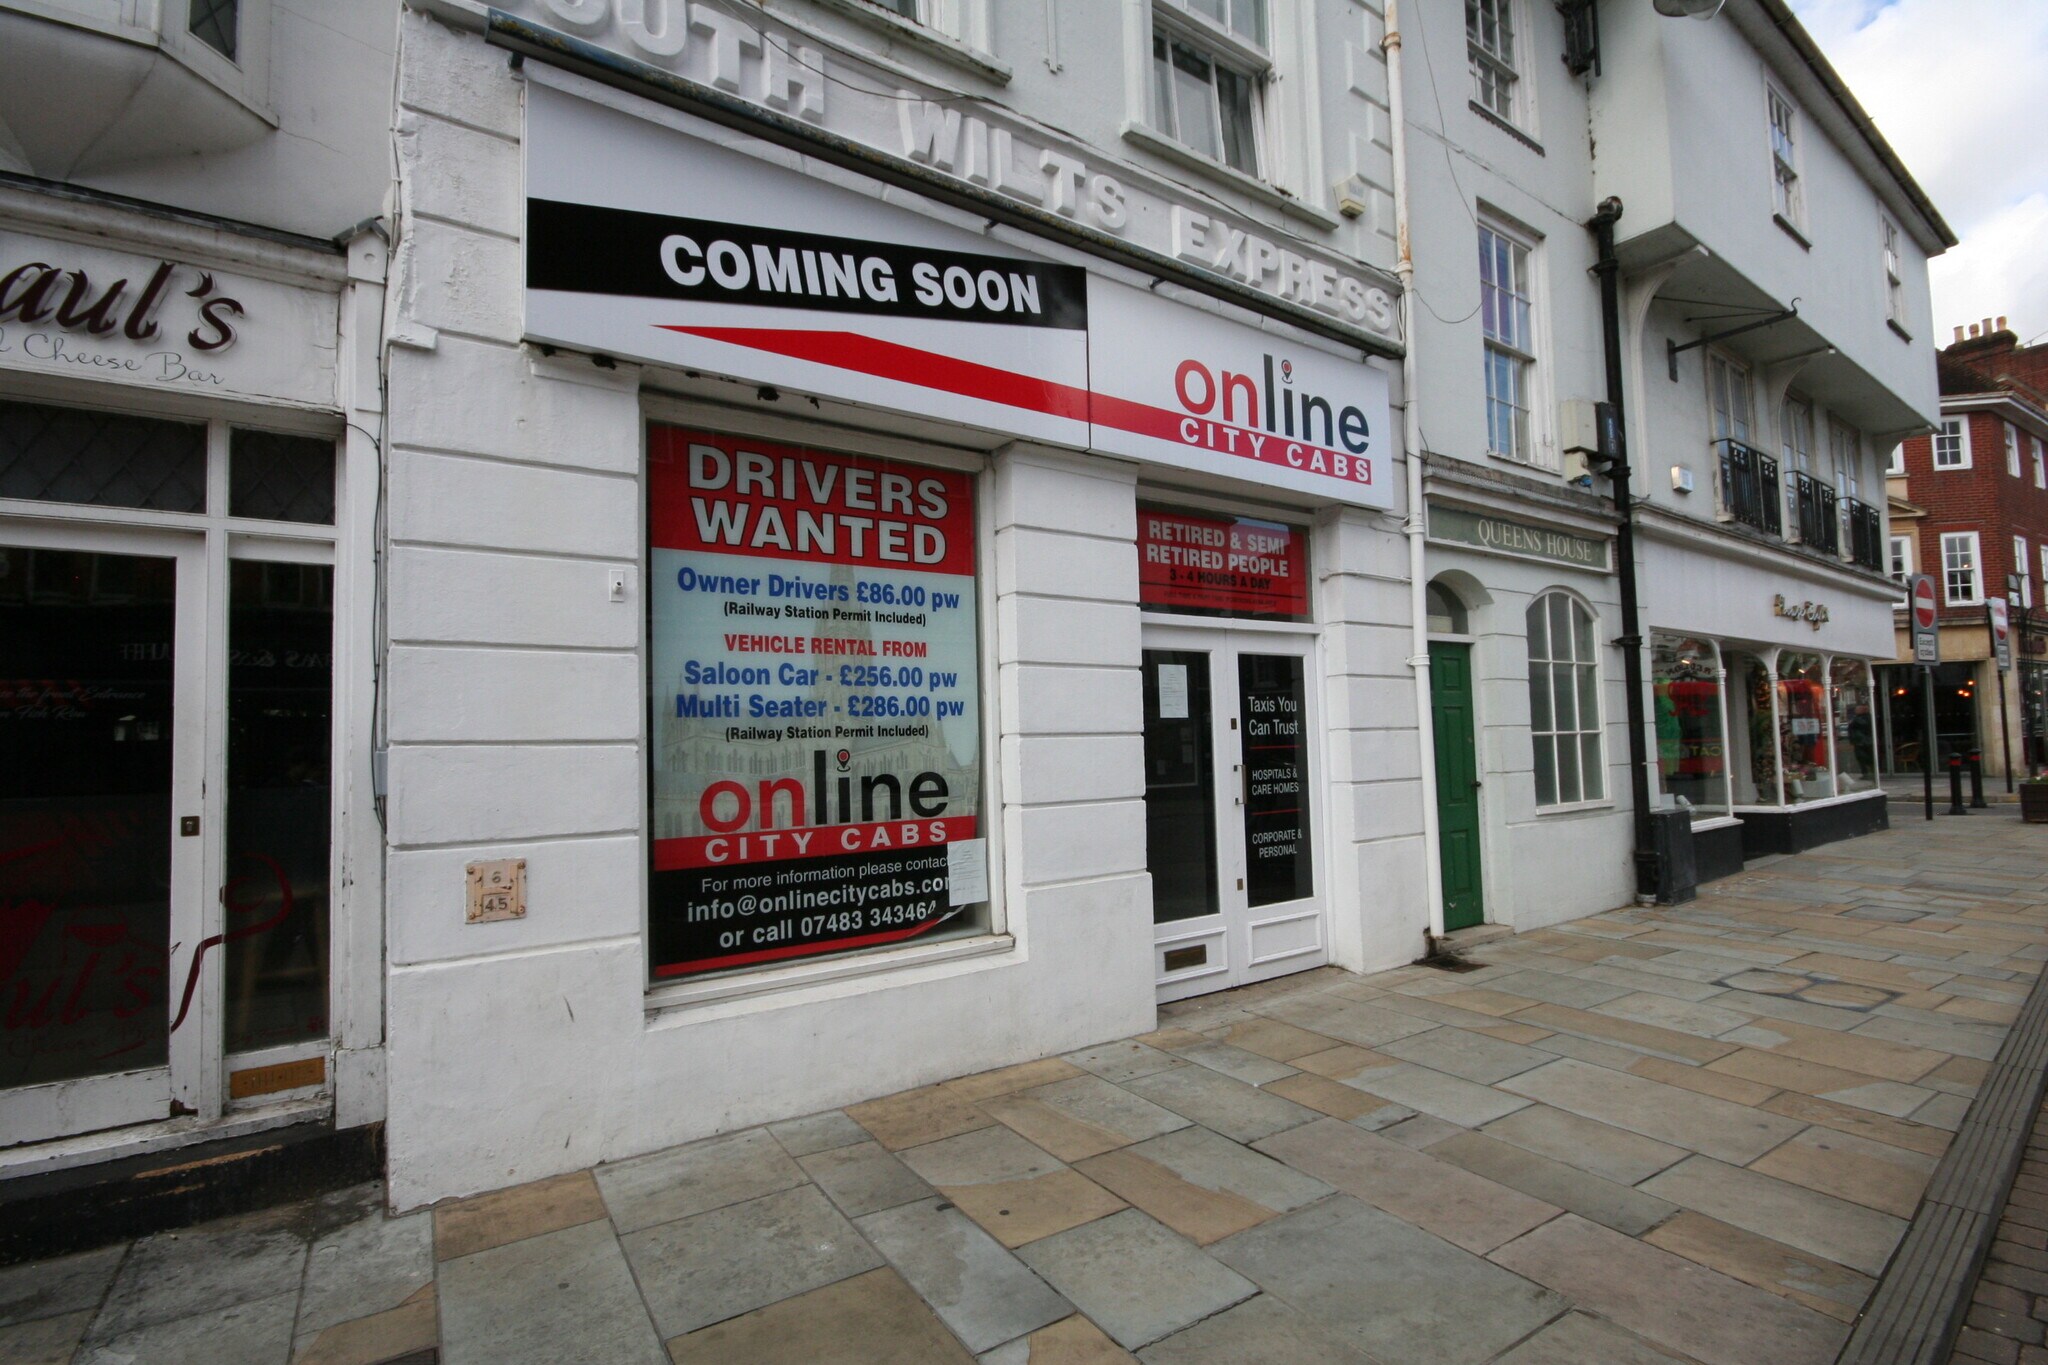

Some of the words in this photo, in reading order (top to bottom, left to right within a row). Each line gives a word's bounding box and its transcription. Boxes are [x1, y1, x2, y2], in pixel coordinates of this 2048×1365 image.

[898, 90, 1127, 234] WILTS
[1171, 205, 1393, 333] EXPRESS
[659, 234, 898, 303] COMING
[912, 262, 1042, 315] SOON
[24, 333, 141, 371] Cheese
[145, 351, 225, 385] Bar
[1174, 353, 1370, 455] online
[1179, 417, 1265, 458] CITY
[1286, 444, 1369, 482] CABS
[687, 443, 949, 520] DRIVERS
[690, 496, 947, 565] WANTED
[1149, 519, 1225, 548] RETIRED
[1230, 531, 1241, 550] &
[1247, 534, 1285, 555] SEMI
[1478, 519, 1542, 552] QUEENS
[1546, 533, 1592, 562] HOUSE
[1146, 543, 1224, 570] RETIRED
[1228, 553, 1289, 577] PEOPLE
[677, 567, 760, 596] Owner
[768, 574, 849, 602] Drivers
[856, 581, 926, 607] £86.00
[931, 591, 960, 612] pw
[1170, 568, 1177, 581] 3
[1187, 570, 1194, 582] 4
[1197, 572, 1238, 587] HOURS
[1240, 576, 1248, 588] A
[1251, 577, 1272, 590] DAY
[723, 601, 781, 620] (Railway
[784, 604, 829, 620] Station
[832, 608, 872, 622] Permit
[875, 611, 927, 628] Included)
[724, 633, 805, 654] VEHICLE
[811, 637, 878, 657] RENTAL
[882, 640, 927, 658] FROM
[684, 660, 771, 686] Saloon
[777, 662, 819, 687] Car
[839, 664, 923, 688] £256.00
[929, 671, 958, 693] pw
[676, 694, 740, 718] Multi
[749, 694, 827, 718] Seater
[847, 695, 930, 718] £286.00
[936, 700, 964, 721] pw
[1248, 696, 1276, 713] Taxis
[1277, 696, 1298, 713] You
[725, 727, 782, 743] (Railway
[786, 726, 832, 740] Station
[835, 725, 874, 739] Permit
[877, 724, 929, 739] Included)
[1248, 719, 1271, 736] Can
[1272, 719, 1299, 735] Trust
[699, 748, 949, 833] online
[1252, 767, 1292, 781] HOSPITALS
[1292, 767, 1298, 779] &
[1252, 783, 1272, 796] CARE
[1273, 781, 1299, 795] HOMES
[705, 832, 813, 863] CITY
[840, 821, 947, 851] CABS
[1252, 830, 1296, 845] CORPORATE
[1297, 828, 1303, 840] &
[1259, 844, 1298, 859] PERSONAL
[492, 871, 501, 883] 6
[701, 878, 729, 894] For
[733, 875, 772, 890] more
[776, 864, 855, 887] information
[859, 862, 902, 880] please
[905, 856, 948, 871] contac
[485, 897, 508, 911] 45
[719, 928, 744, 949] or
[752, 919, 793, 944] call
[800, 910, 863, 938] 07483
